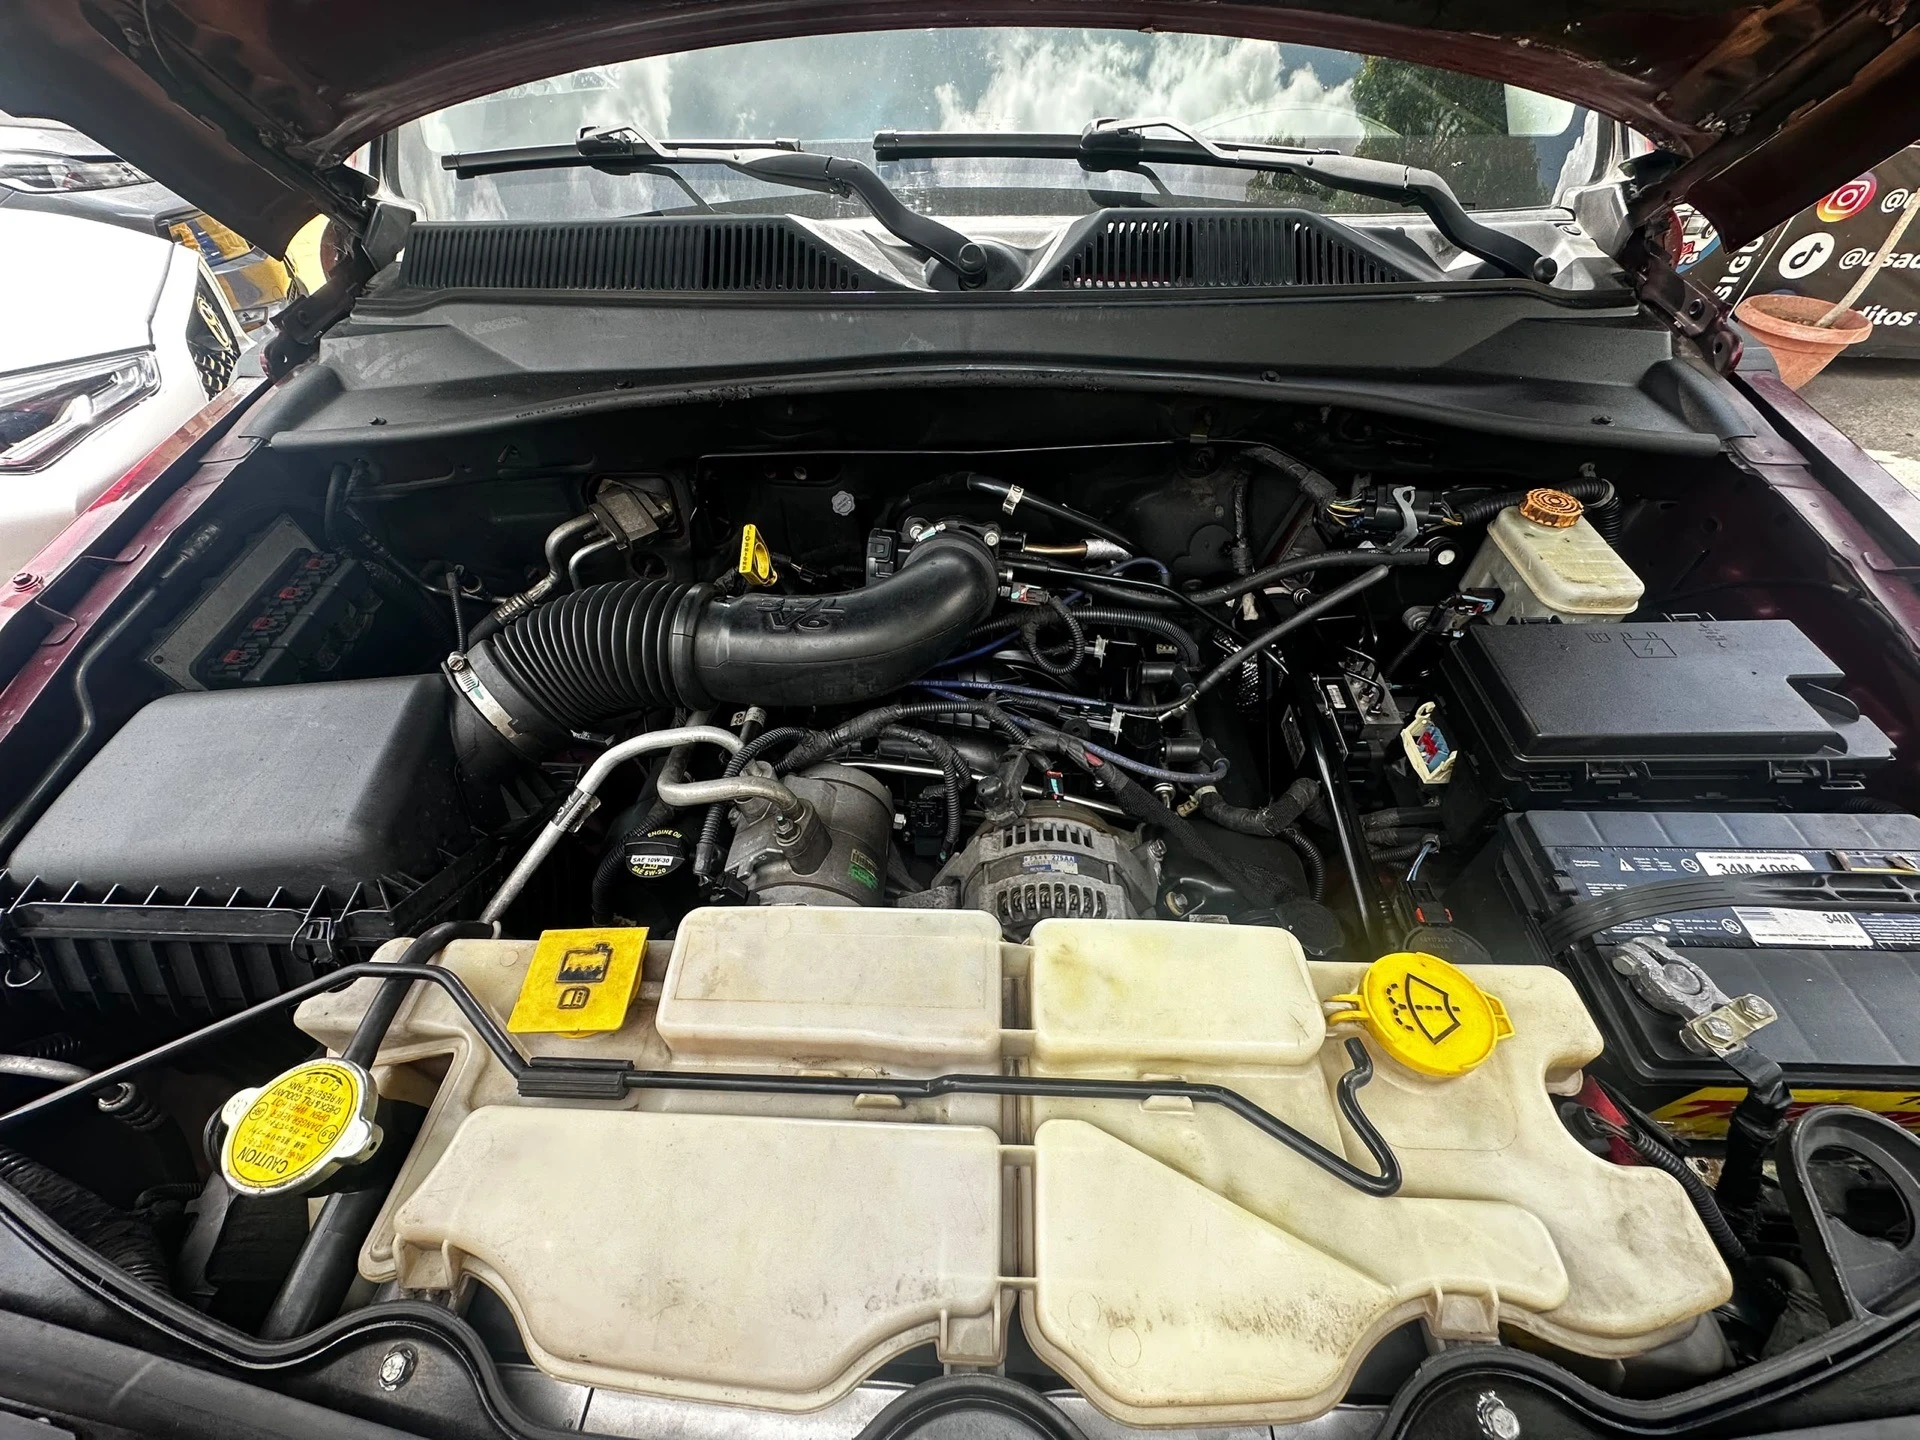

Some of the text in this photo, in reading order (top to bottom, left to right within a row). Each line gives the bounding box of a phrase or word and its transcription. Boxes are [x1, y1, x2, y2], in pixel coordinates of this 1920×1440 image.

[769, 611, 830, 631] V6
[647, 829, 673, 838] ENGINE
[1822, 913, 1854, 925] 34M
[305, 1076, 340, 1091] CLOSE
[272, 1088, 302, 1102] COOLANT
[289, 1081, 346, 1105] IN RESERVE TANK
[270, 1097, 287, 1108] HOT
[319, 1102, 342, 1115] CHECK
[310, 1111, 331, 1122] OPEN
[236, 1146, 289, 1174] CAUTION
